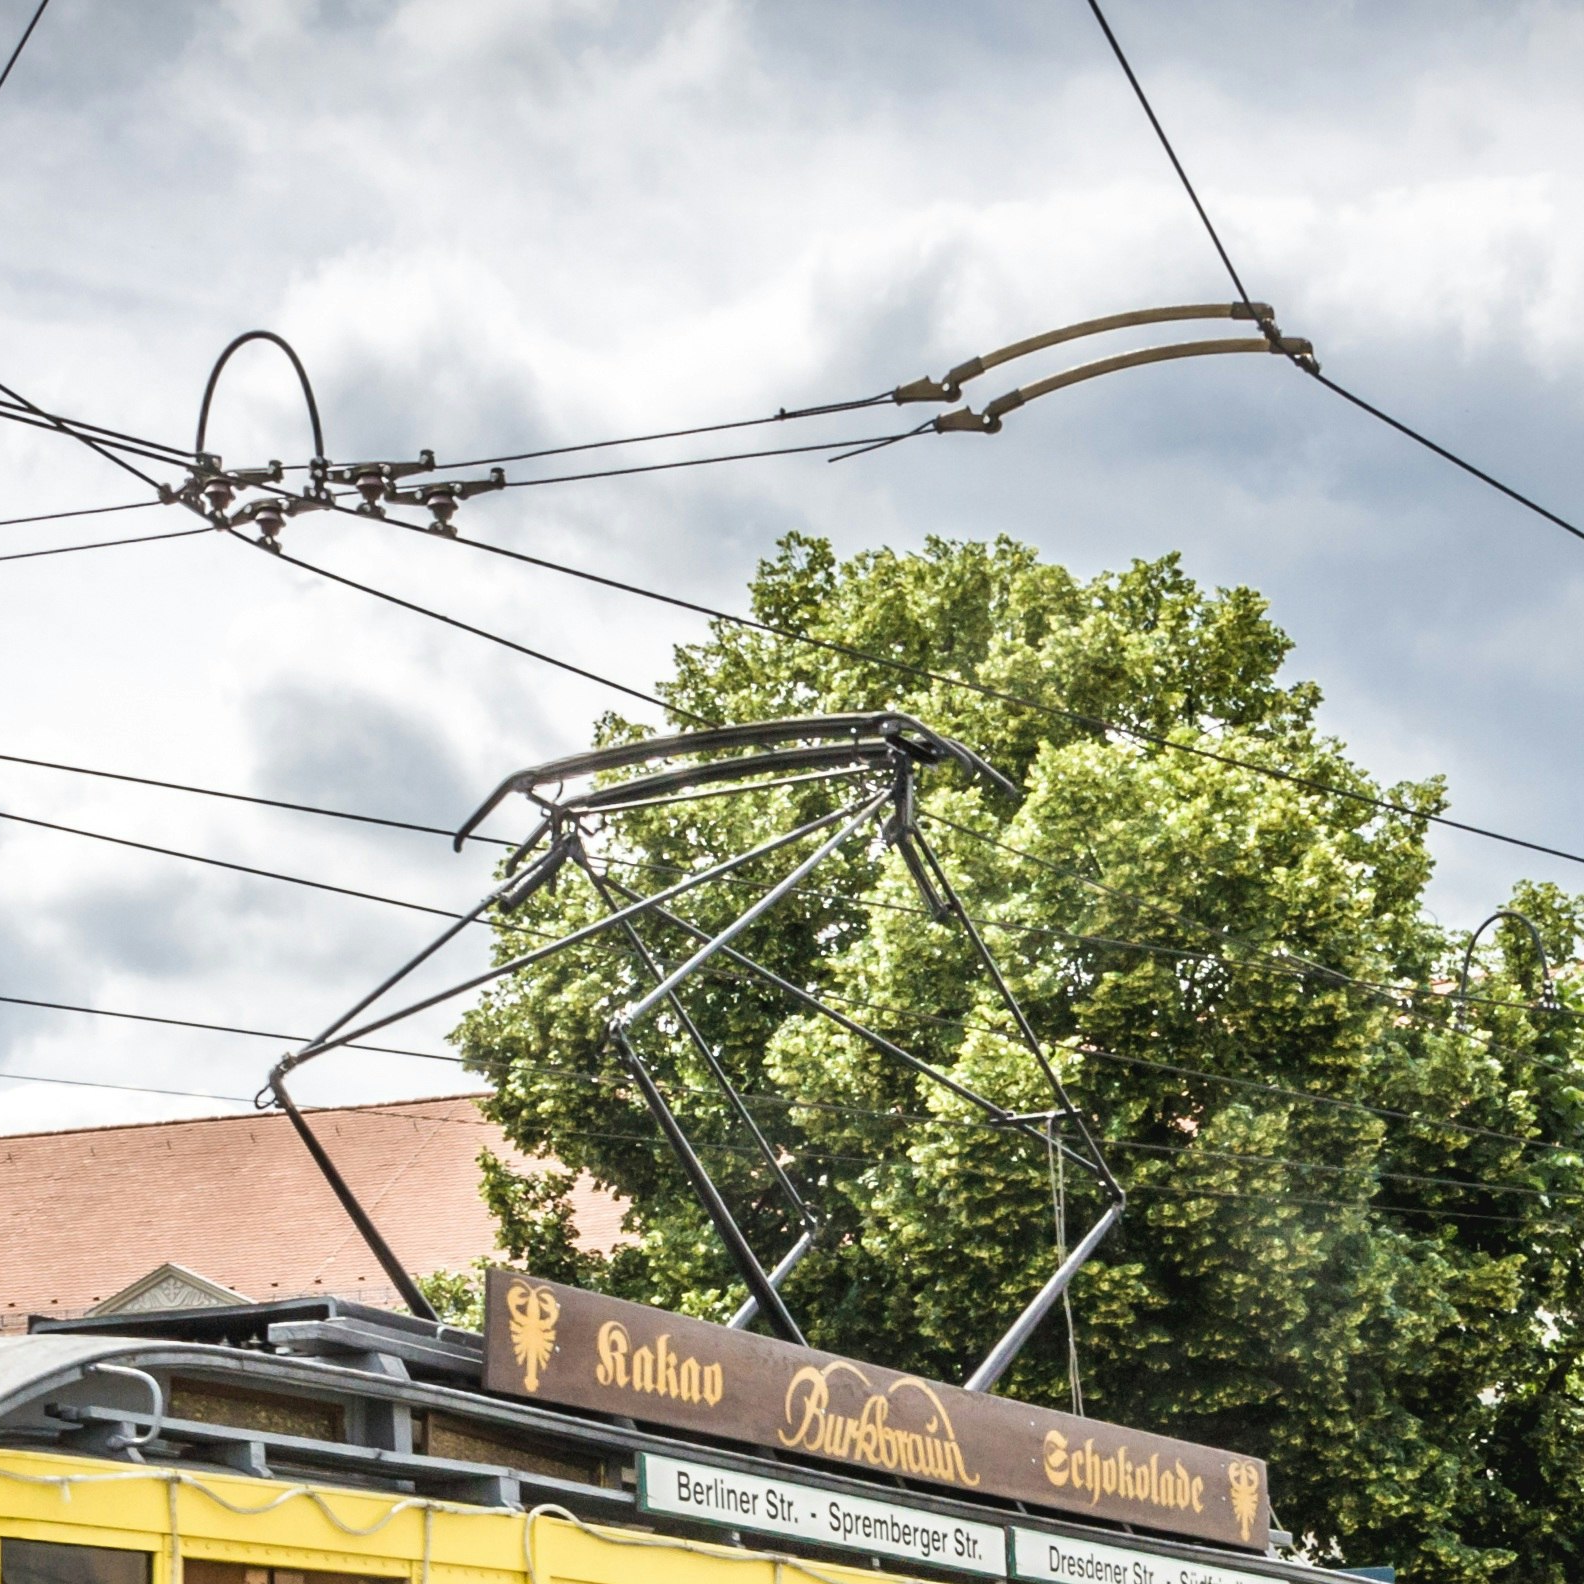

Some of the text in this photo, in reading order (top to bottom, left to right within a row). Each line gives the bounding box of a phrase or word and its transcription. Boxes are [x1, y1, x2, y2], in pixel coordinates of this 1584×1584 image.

[596, 1321, 1204, 1513] Kakao Burkbraun Schokolade
[676, 1471, 759, 1516] Berliner
[766, 1488, 799, 1524] Str.
[828, 1501, 948, 1557] Spremberger
[953, 1527, 983, 1560] Str.
